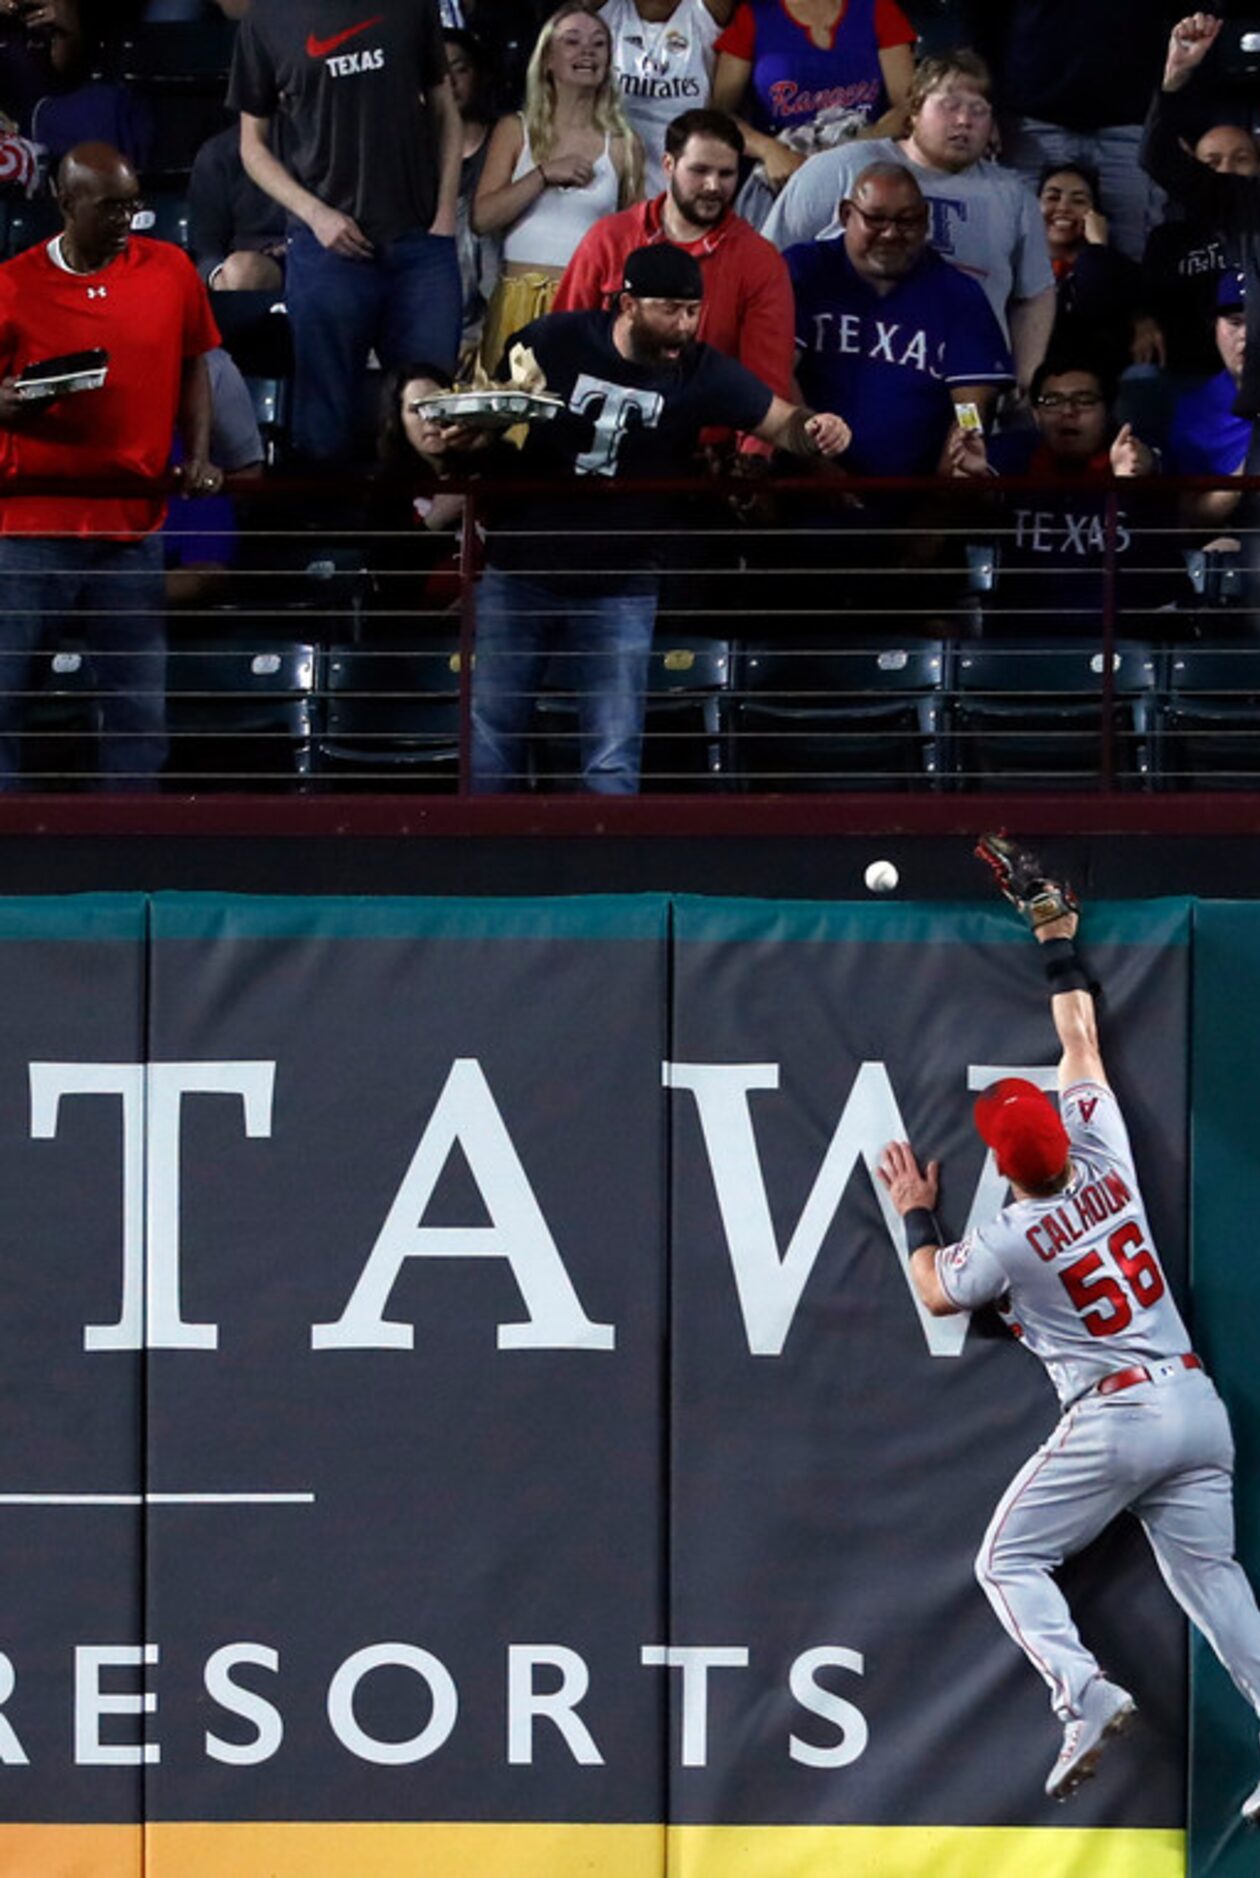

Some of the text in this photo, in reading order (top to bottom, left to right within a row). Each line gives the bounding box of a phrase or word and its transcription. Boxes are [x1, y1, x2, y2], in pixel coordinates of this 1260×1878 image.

[325, 49, 385, 78] TEXAS
[614, 67, 700, 98] mirates
[569, 373, 664, 476] T
[1026, 1168, 1132, 1262] CALHOUN
[1058, 1220, 1165, 1338] 56
